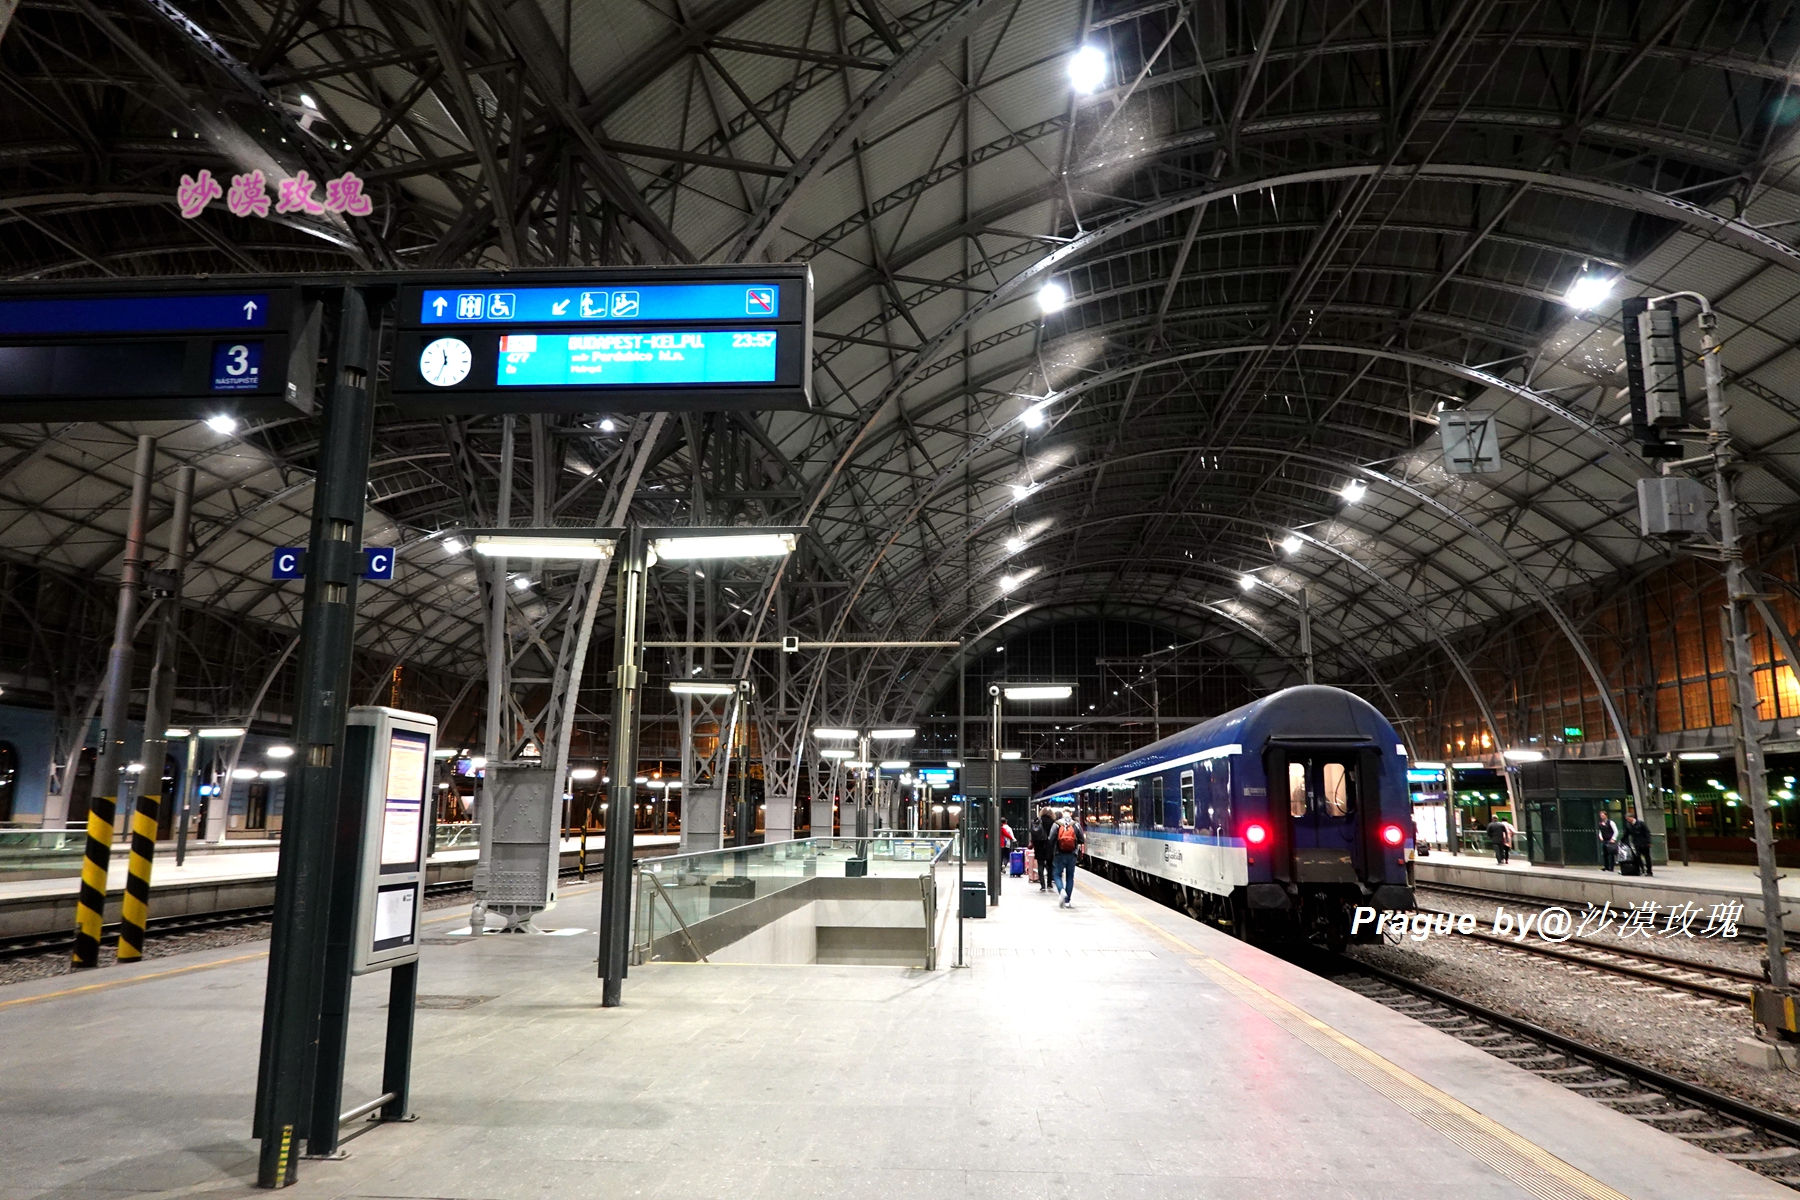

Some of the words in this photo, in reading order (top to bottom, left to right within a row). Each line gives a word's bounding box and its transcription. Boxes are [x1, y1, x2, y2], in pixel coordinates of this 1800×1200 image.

[732, 334, 777, 348] 23:57
[226, 345, 258, 375] 3.
[279, 555, 295, 572] C
[371, 555, 387, 573] C
